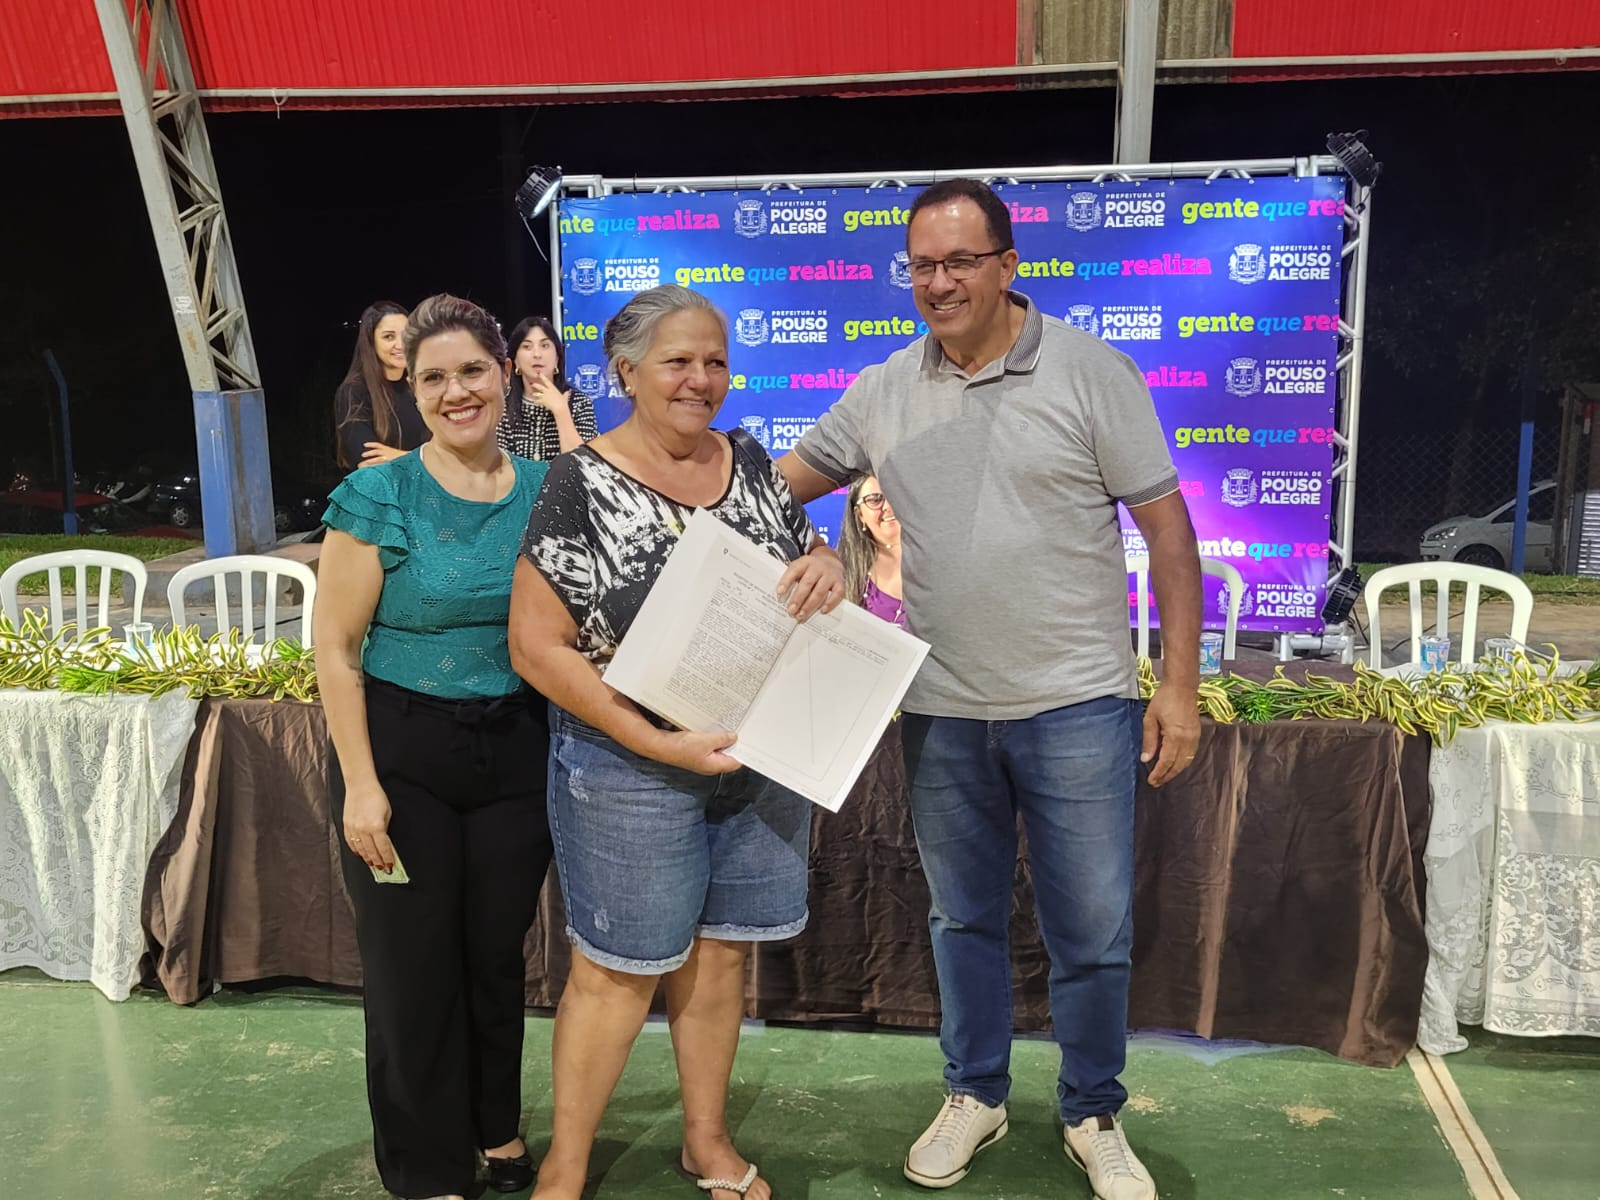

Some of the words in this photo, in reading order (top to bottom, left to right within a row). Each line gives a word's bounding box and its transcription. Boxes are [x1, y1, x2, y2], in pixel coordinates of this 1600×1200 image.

[1105, 200, 1166, 215] POUSO
[1181, 197, 1259, 224] gente
[1261, 200, 1306, 221] que
[770, 208, 827, 222] POUSO
[1104, 215, 1165, 228] ALEGRE
[597, 217, 636, 237] que
[637, 209, 720, 232] realiza
[770, 222, 827, 235] ALEGRE
[1269, 252, 1332, 268] POUSO
[605, 265, 660, 279] POUSO
[675, 264, 745, 289] gente
[748, 266, 788, 286] que
[788, 260, 874, 281] realiza
[1012, 257, 1075, 282] ente
[1077, 261, 1121, 281] que
[1121, 253, 1212, 276] realiza
[1267, 268, 1331, 281] ALEGRE
[772, 317, 828, 331] POUSO
[1102, 313, 1163, 328] POUSO
[1178, 312, 1255, 338] gente
[1256, 316, 1302, 335] que
[843, 316, 915, 341] gente
[1101, 328, 1162, 340] ALEGRE
[771, 331, 828, 343] ALEGRE
[748, 375, 790, 393] que
[790, 368, 860, 389] realiz
[1142, 365, 1208, 387] aliza
[1266, 367, 1327, 381] POUSO
[1264, 381, 1326, 394] ALEGRE
[773, 424, 815, 438] POU
[1175, 424, 1251, 448] gente
[1253, 428, 1298, 447] que
[1261, 478, 1322, 492] POUSO
[1260, 492, 1321, 504] ALEGRE
[1198, 537, 1247, 557] nte
[1247, 542, 1293, 561] que
[1256, 590, 1318, 605] POUSO
[1255, 604, 1317, 618] ALEGRE
